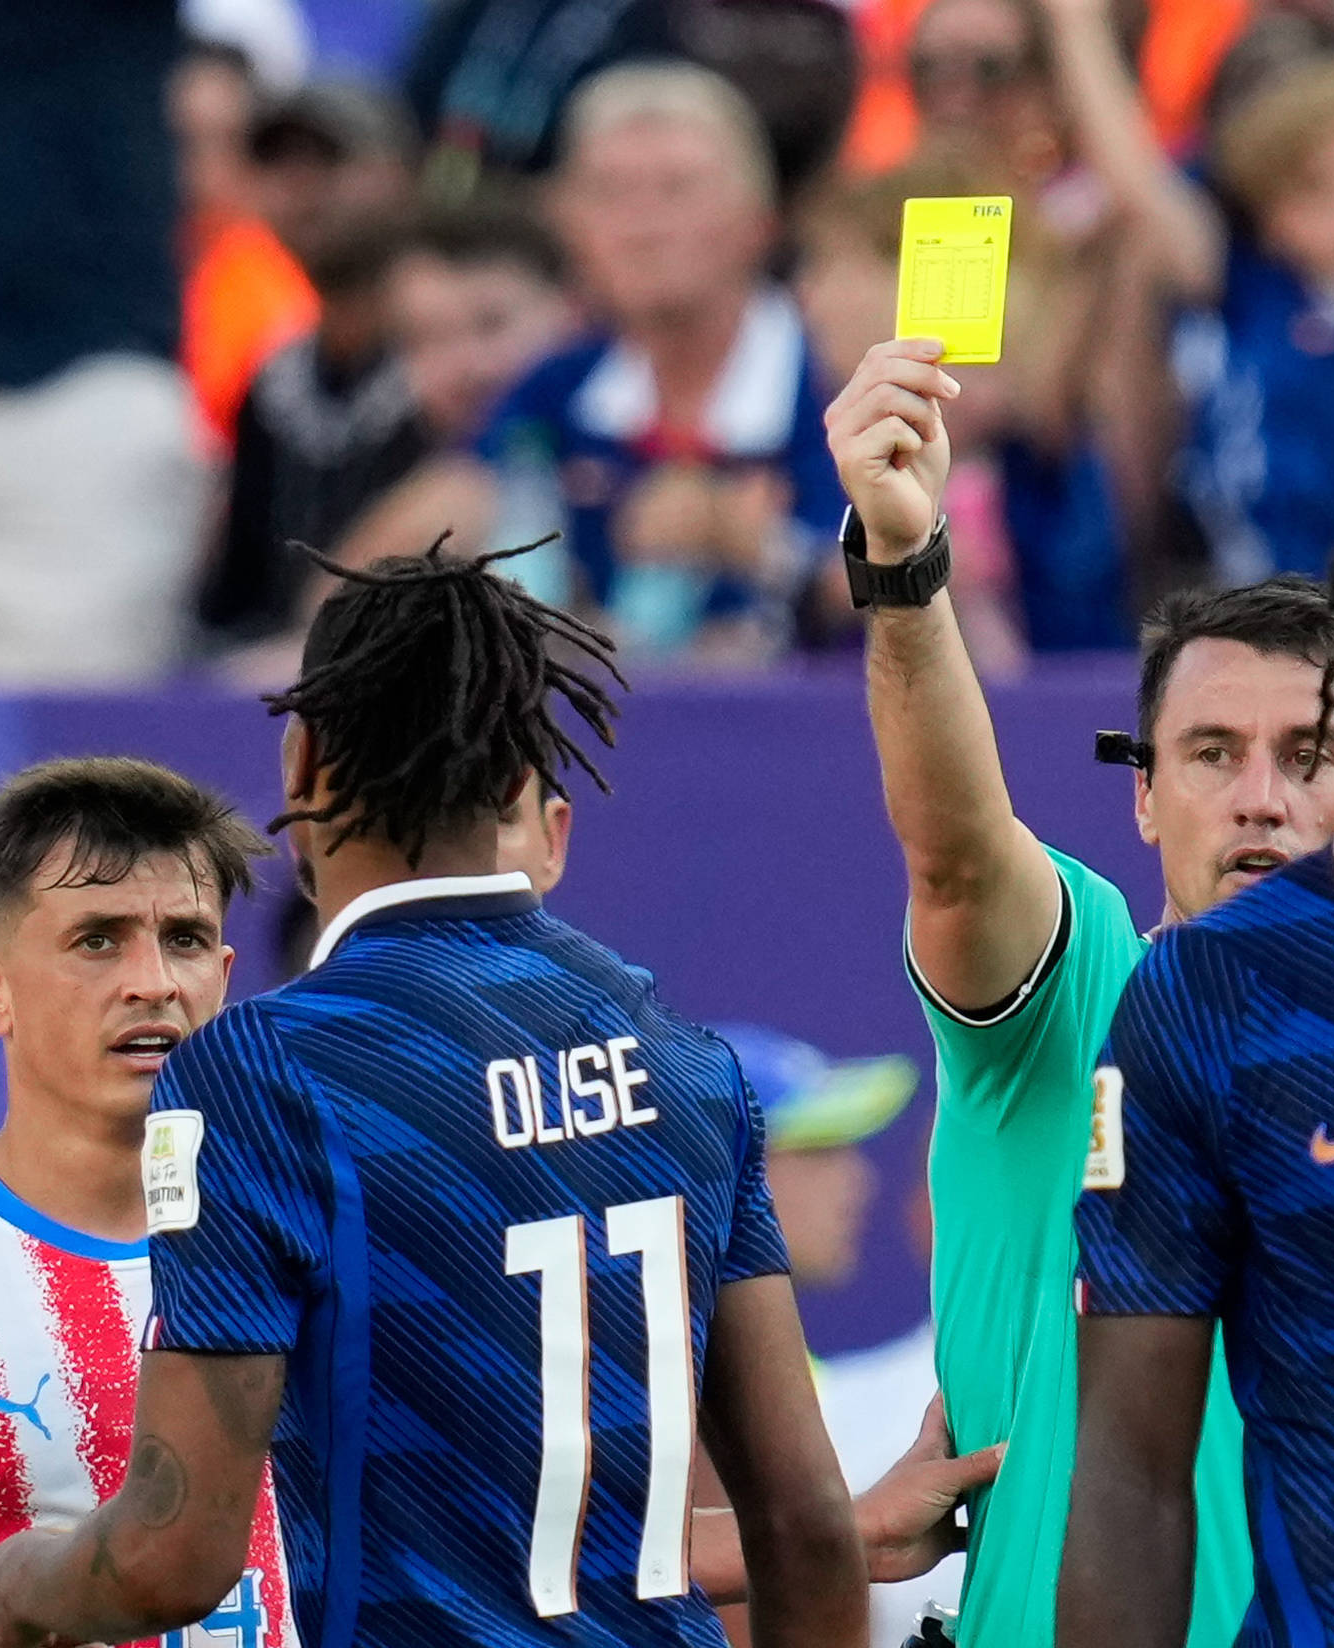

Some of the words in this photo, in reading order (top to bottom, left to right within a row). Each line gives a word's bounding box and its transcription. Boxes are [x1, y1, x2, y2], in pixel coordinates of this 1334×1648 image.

[972, 205, 1003, 217] FIFA
[486, 1036, 658, 1149] OLISE
[505, 1195, 698, 1618] 11
